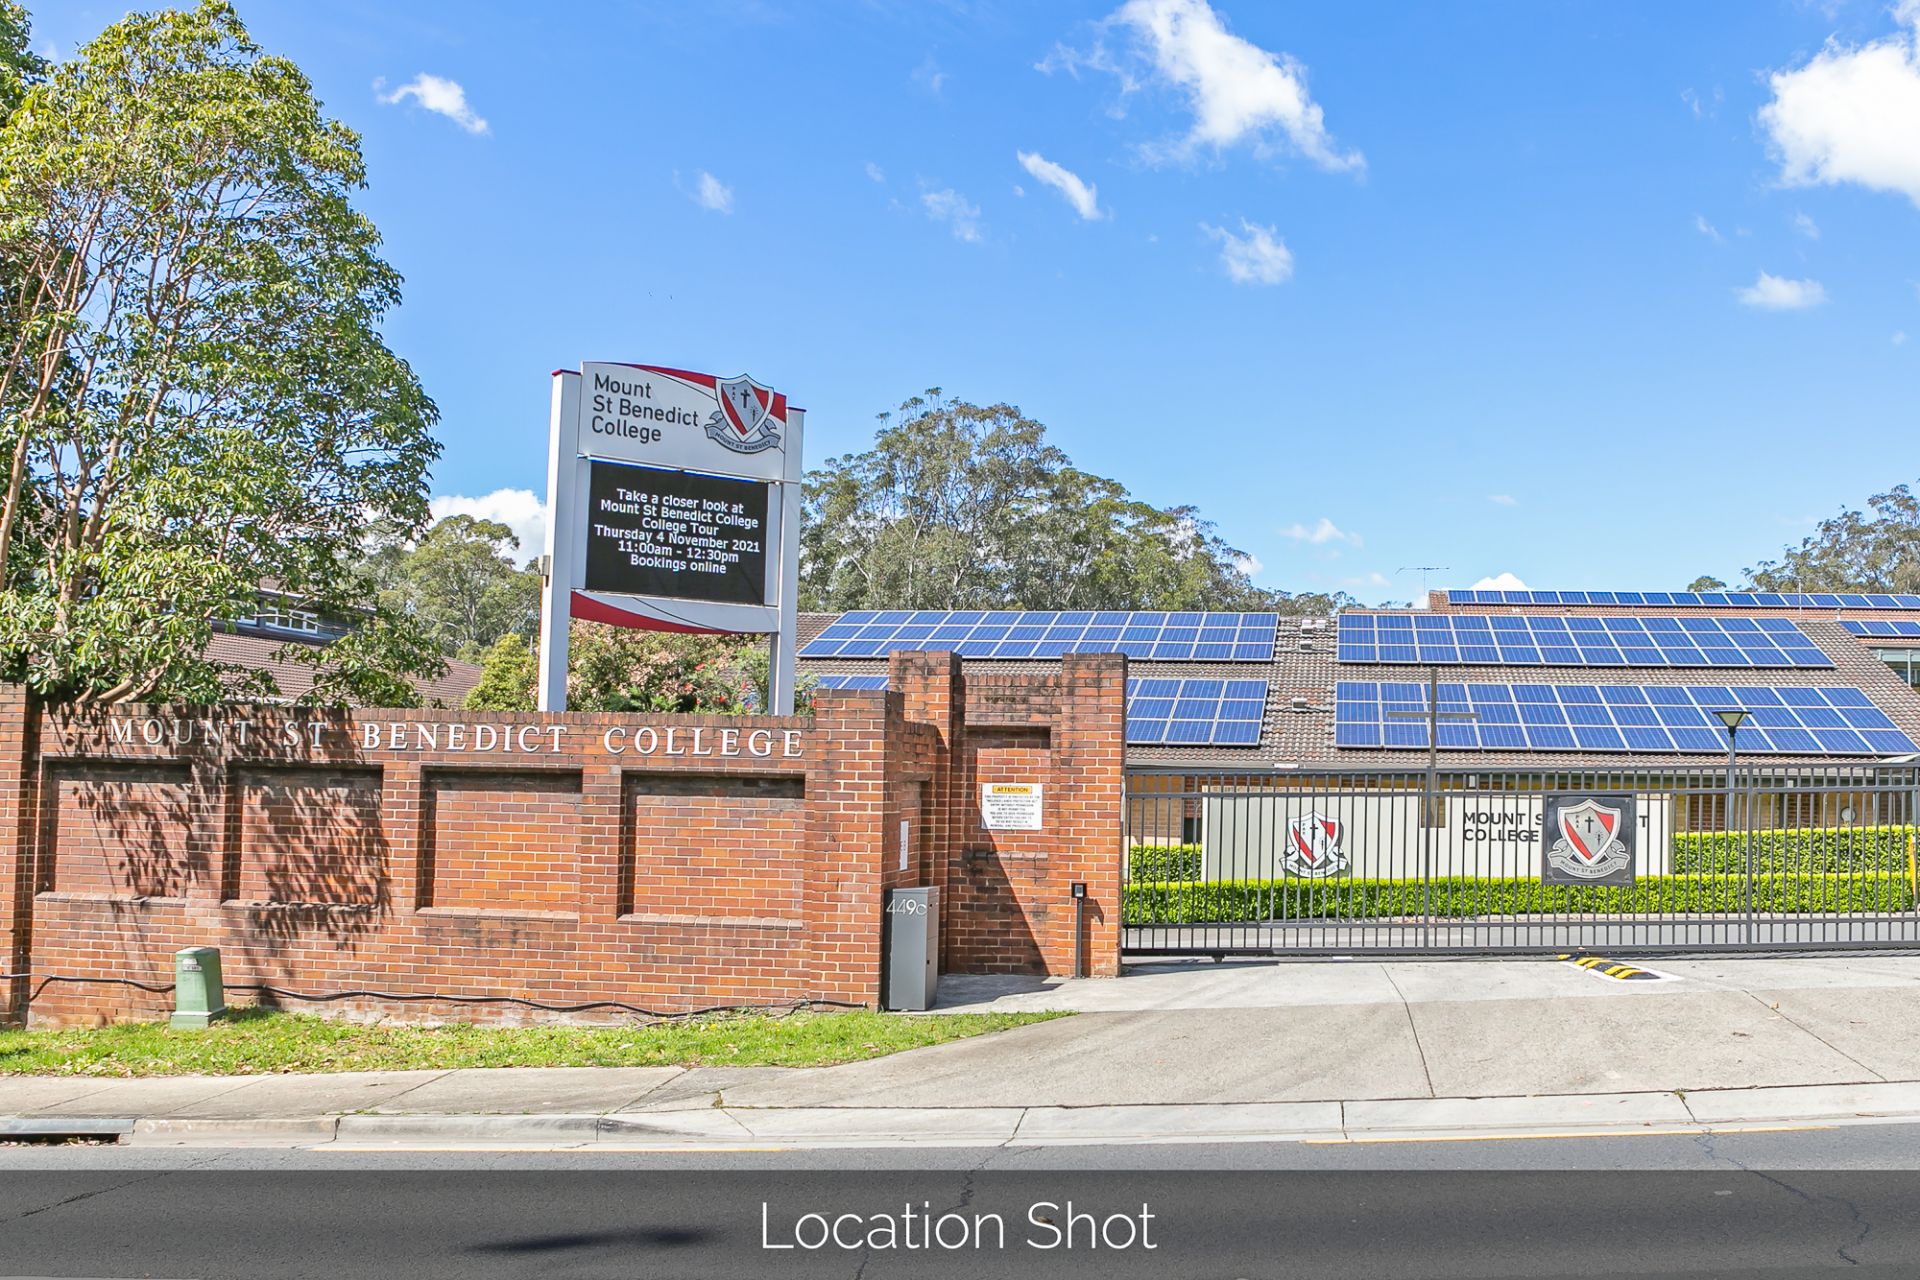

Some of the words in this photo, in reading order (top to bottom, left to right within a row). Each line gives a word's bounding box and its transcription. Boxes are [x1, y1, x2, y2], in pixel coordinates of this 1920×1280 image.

[594, 373, 651, 399] Mount
[592, 394, 613, 414] St
[619, 398, 699, 427] Benedict
[591, 415, 662, 444] College
[714, 432, 735, 447] MOUNT
[616, 488, 648, 503] Take
[651, 494, 659, 504] a
[662, 494, 699, 509] closer
[702, 498, 729, 513] look
[731, 503, 744, 514] at
[600, 499, 640, 515] Mount
[643, 504, 657, 517] St
[661, 506, 712, 523] Benedict
[715, 513, 759, 530] College
[642, 517, 687, 534] College
[690, 522, 719, 536] Tour
[593, 524, 653, 543] Thursday
[656, 531, 665, 542] 4
[668, 532, 729, 550] November
[732, 539, 760, 553] 2021
[618, 540, 673, 556] 11:00am
[686, 547, 739, 564] 12:30pm
[630, 554, 687, 572] Bookings
[690, 561, 727, 574] online
[110, 718, 254, 746] MOUNT
[283, 721, 329, 749] ST
[362, 722, 568, 753] BENEDICT
[603, 726, 804, 757] COLLEGE
[1464, 812, 1526, 825] MOUNT
[1464, 829, 1540, 842] COLLEGE
[1560, 860, 1580, 872] MOUNT
